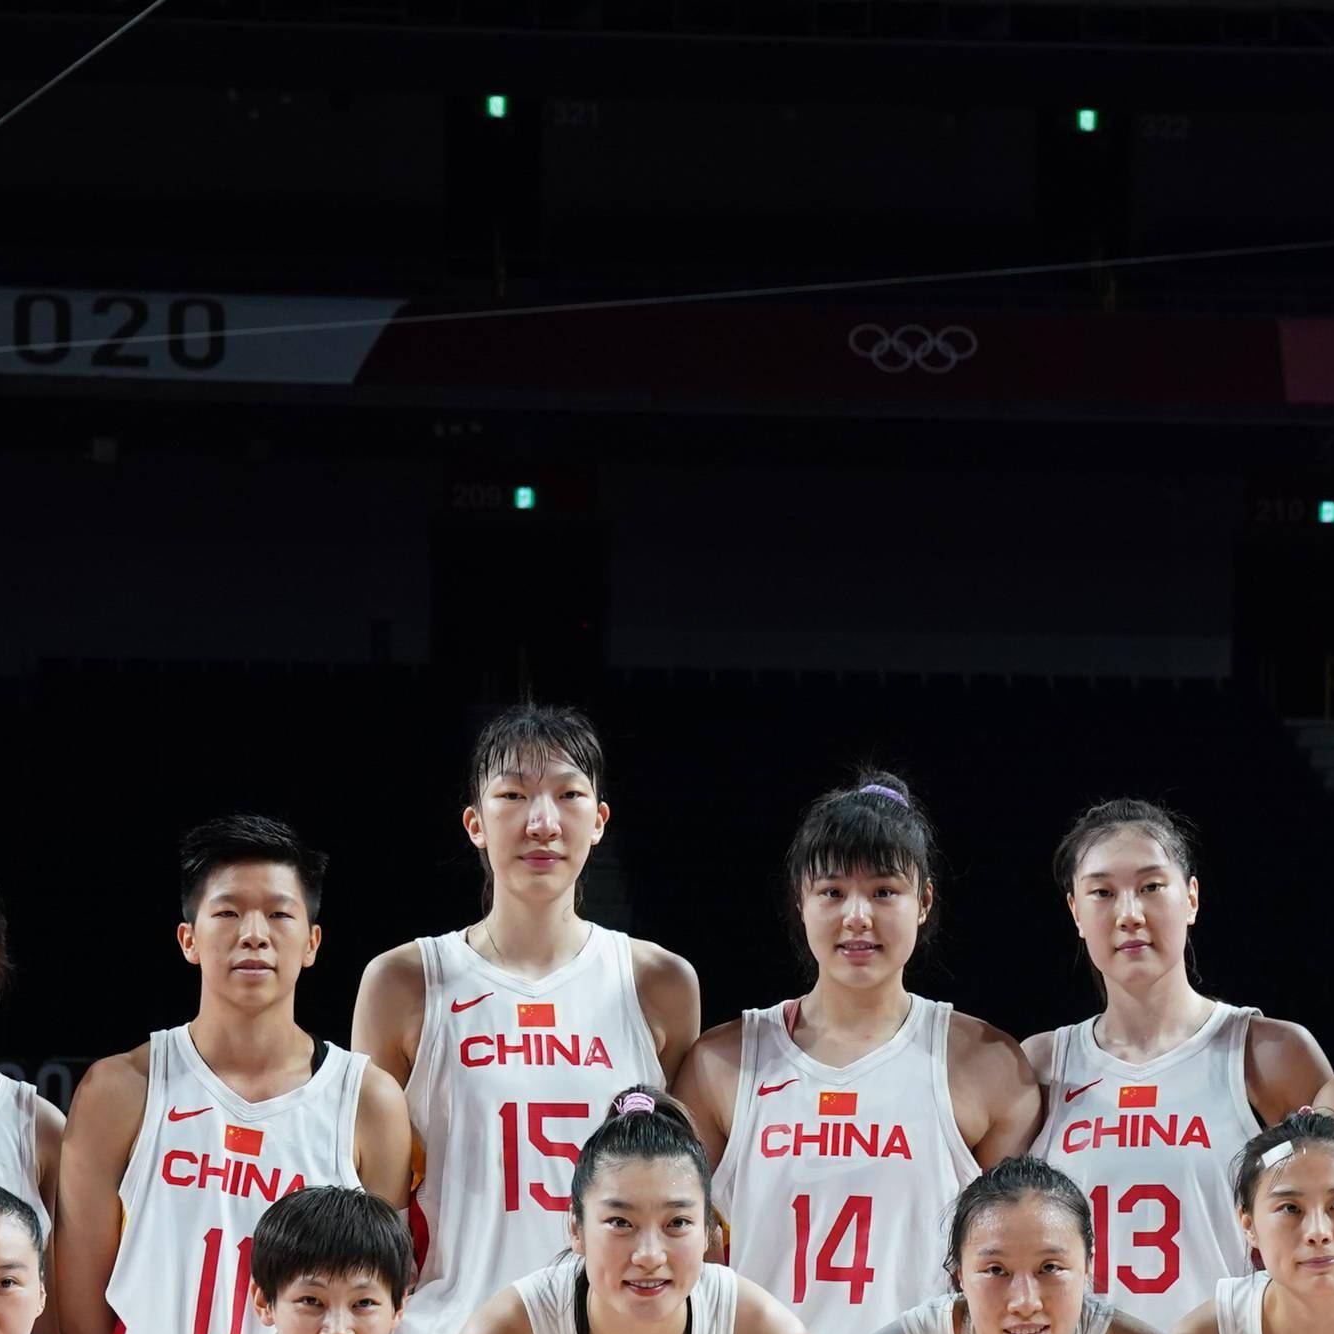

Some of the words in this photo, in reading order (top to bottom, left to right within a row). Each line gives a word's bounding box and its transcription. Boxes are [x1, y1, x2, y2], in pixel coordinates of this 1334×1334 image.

[460, 1033, 613, 1069] CHINA
[498, 1102, 589, 1213] 15
[761, 1122, 913, 1160] CHINA
[1062, 1113, 1211, 1154] CHINA
[791, 1194, 874, 1305] 14
[1090, 1184, 1181, 1294] 13
